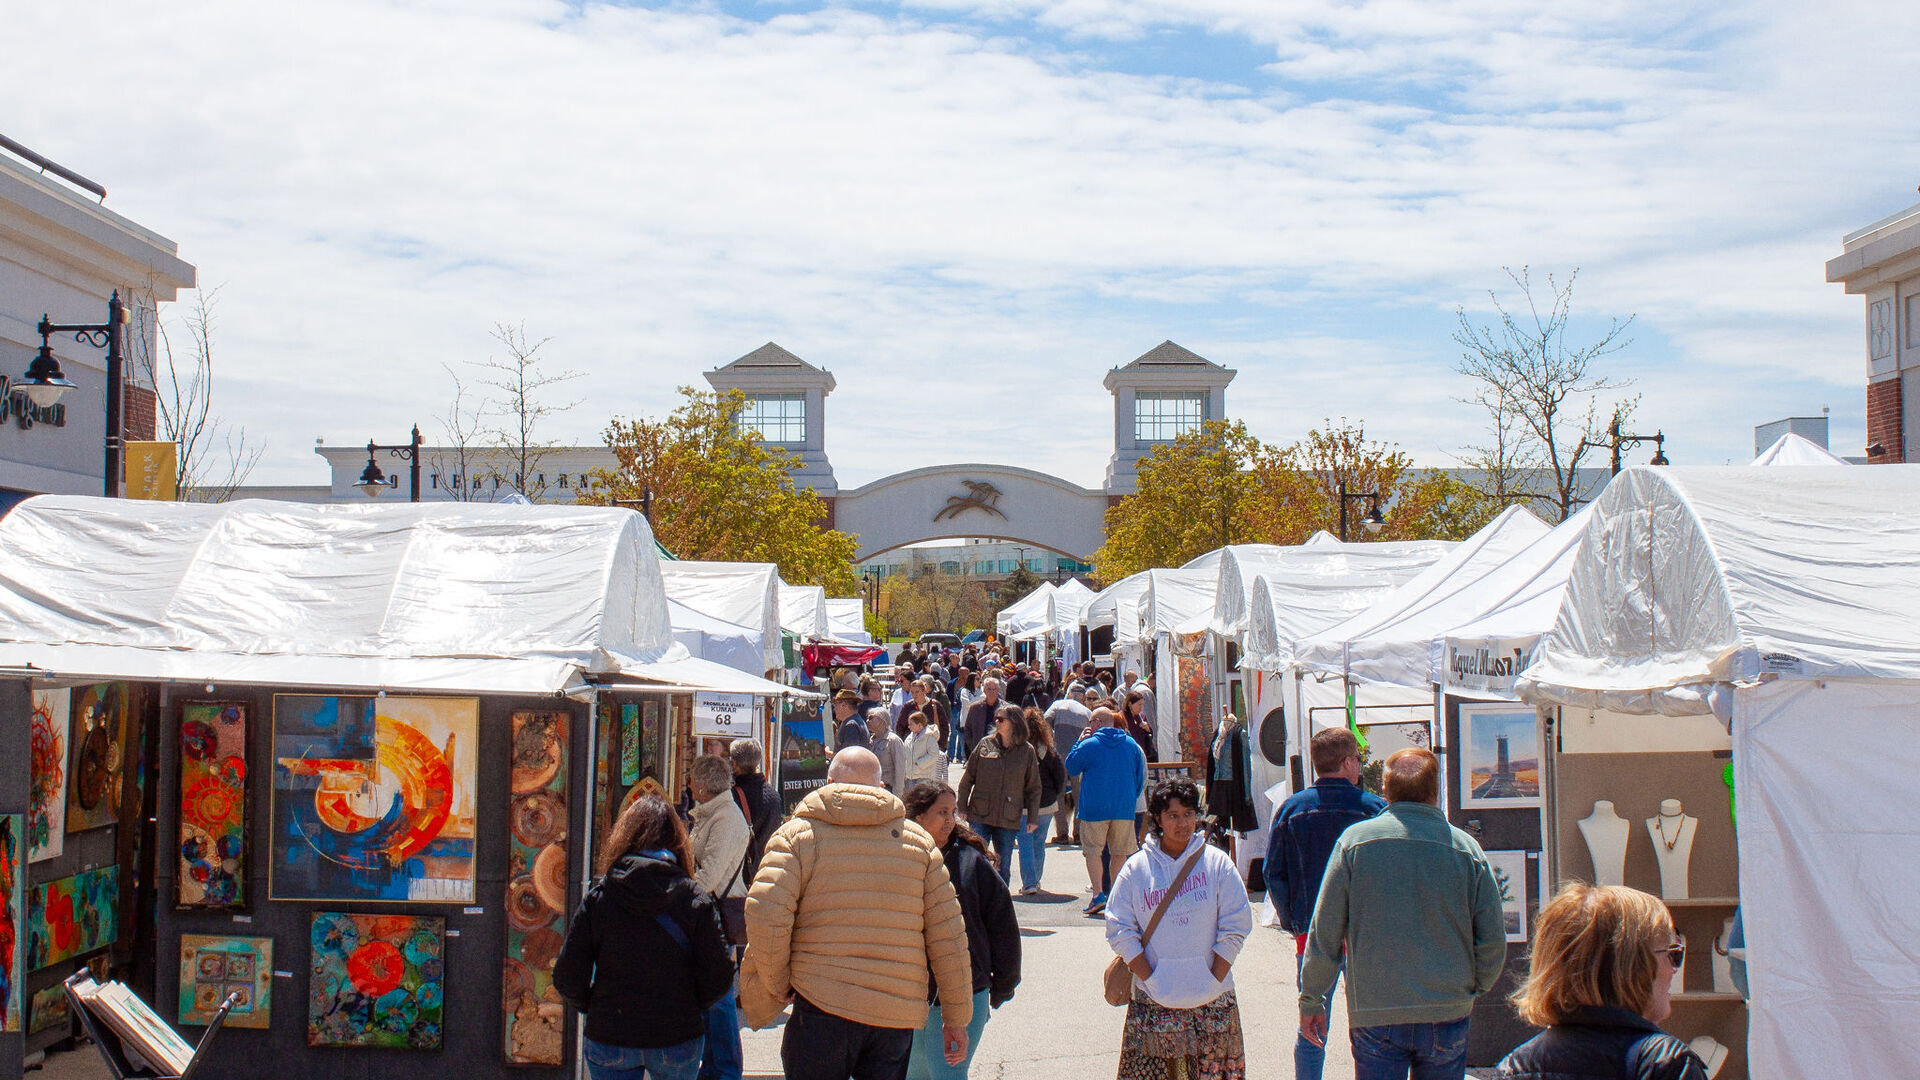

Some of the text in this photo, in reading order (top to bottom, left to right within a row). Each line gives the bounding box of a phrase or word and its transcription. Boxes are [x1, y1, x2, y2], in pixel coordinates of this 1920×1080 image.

[143, 452, 153, 492] PARK
[715, 713, 732, 726] 68
[783, 780, 803, 790] ENTER
[803, 779, 812, 789] TO
[1193, 890, 1208, 902] USA
